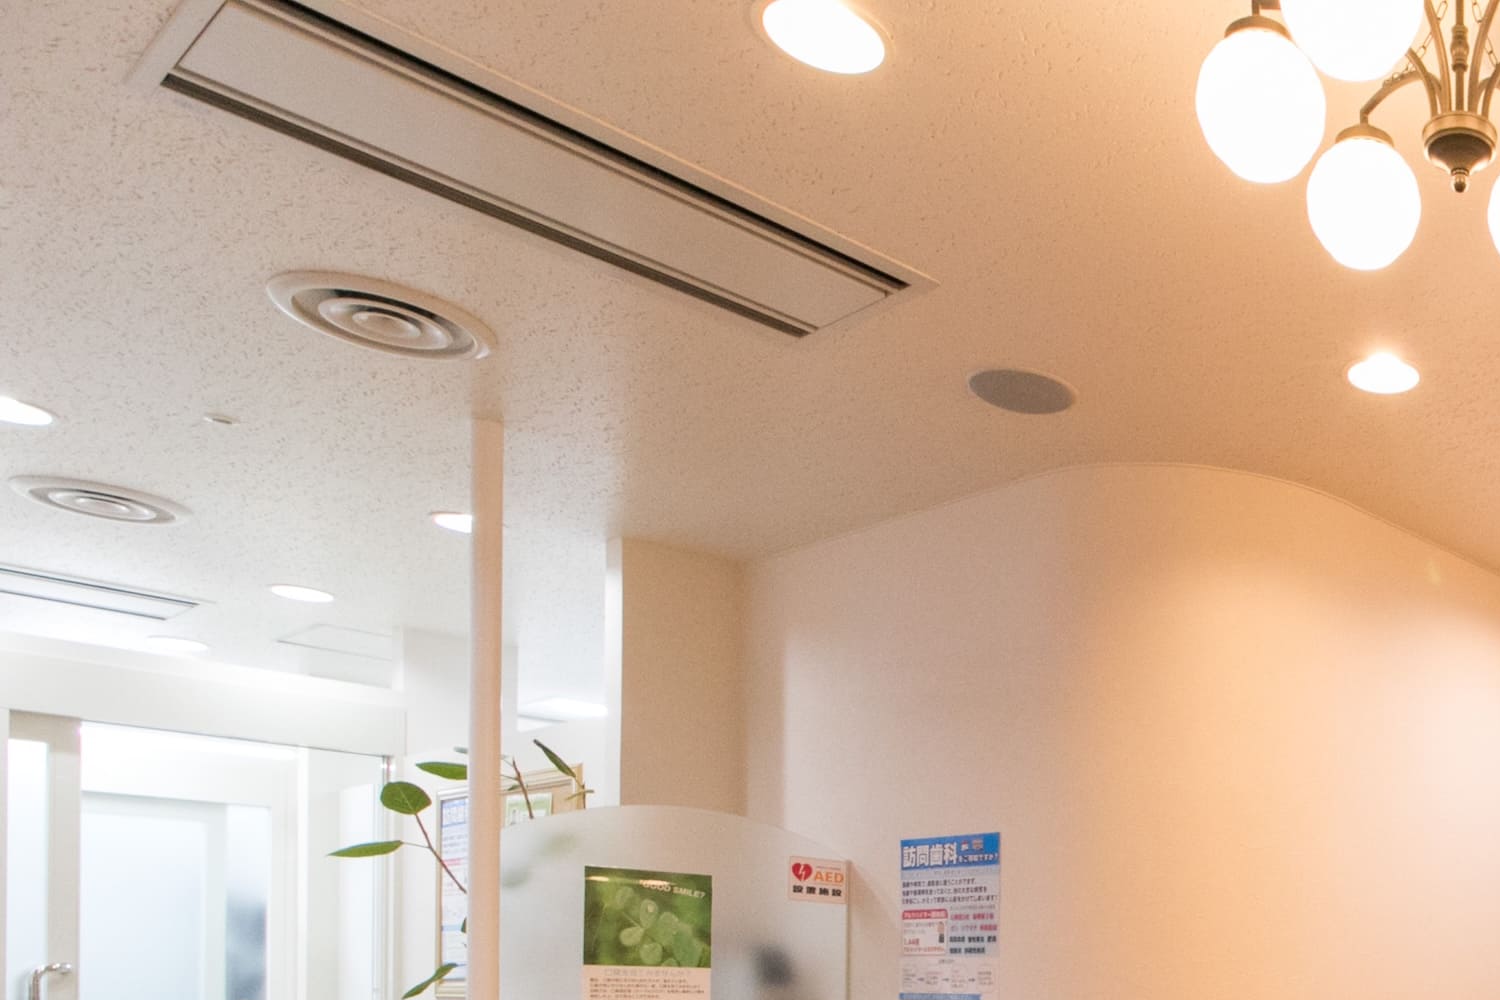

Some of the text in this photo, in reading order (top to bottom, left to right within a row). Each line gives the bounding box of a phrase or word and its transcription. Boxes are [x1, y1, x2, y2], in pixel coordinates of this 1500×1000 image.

[902, 842, 958, 869] 訪問歯科
[814, 871, 844, 883] AED
[792, 884, 842, 897] 設置施設
